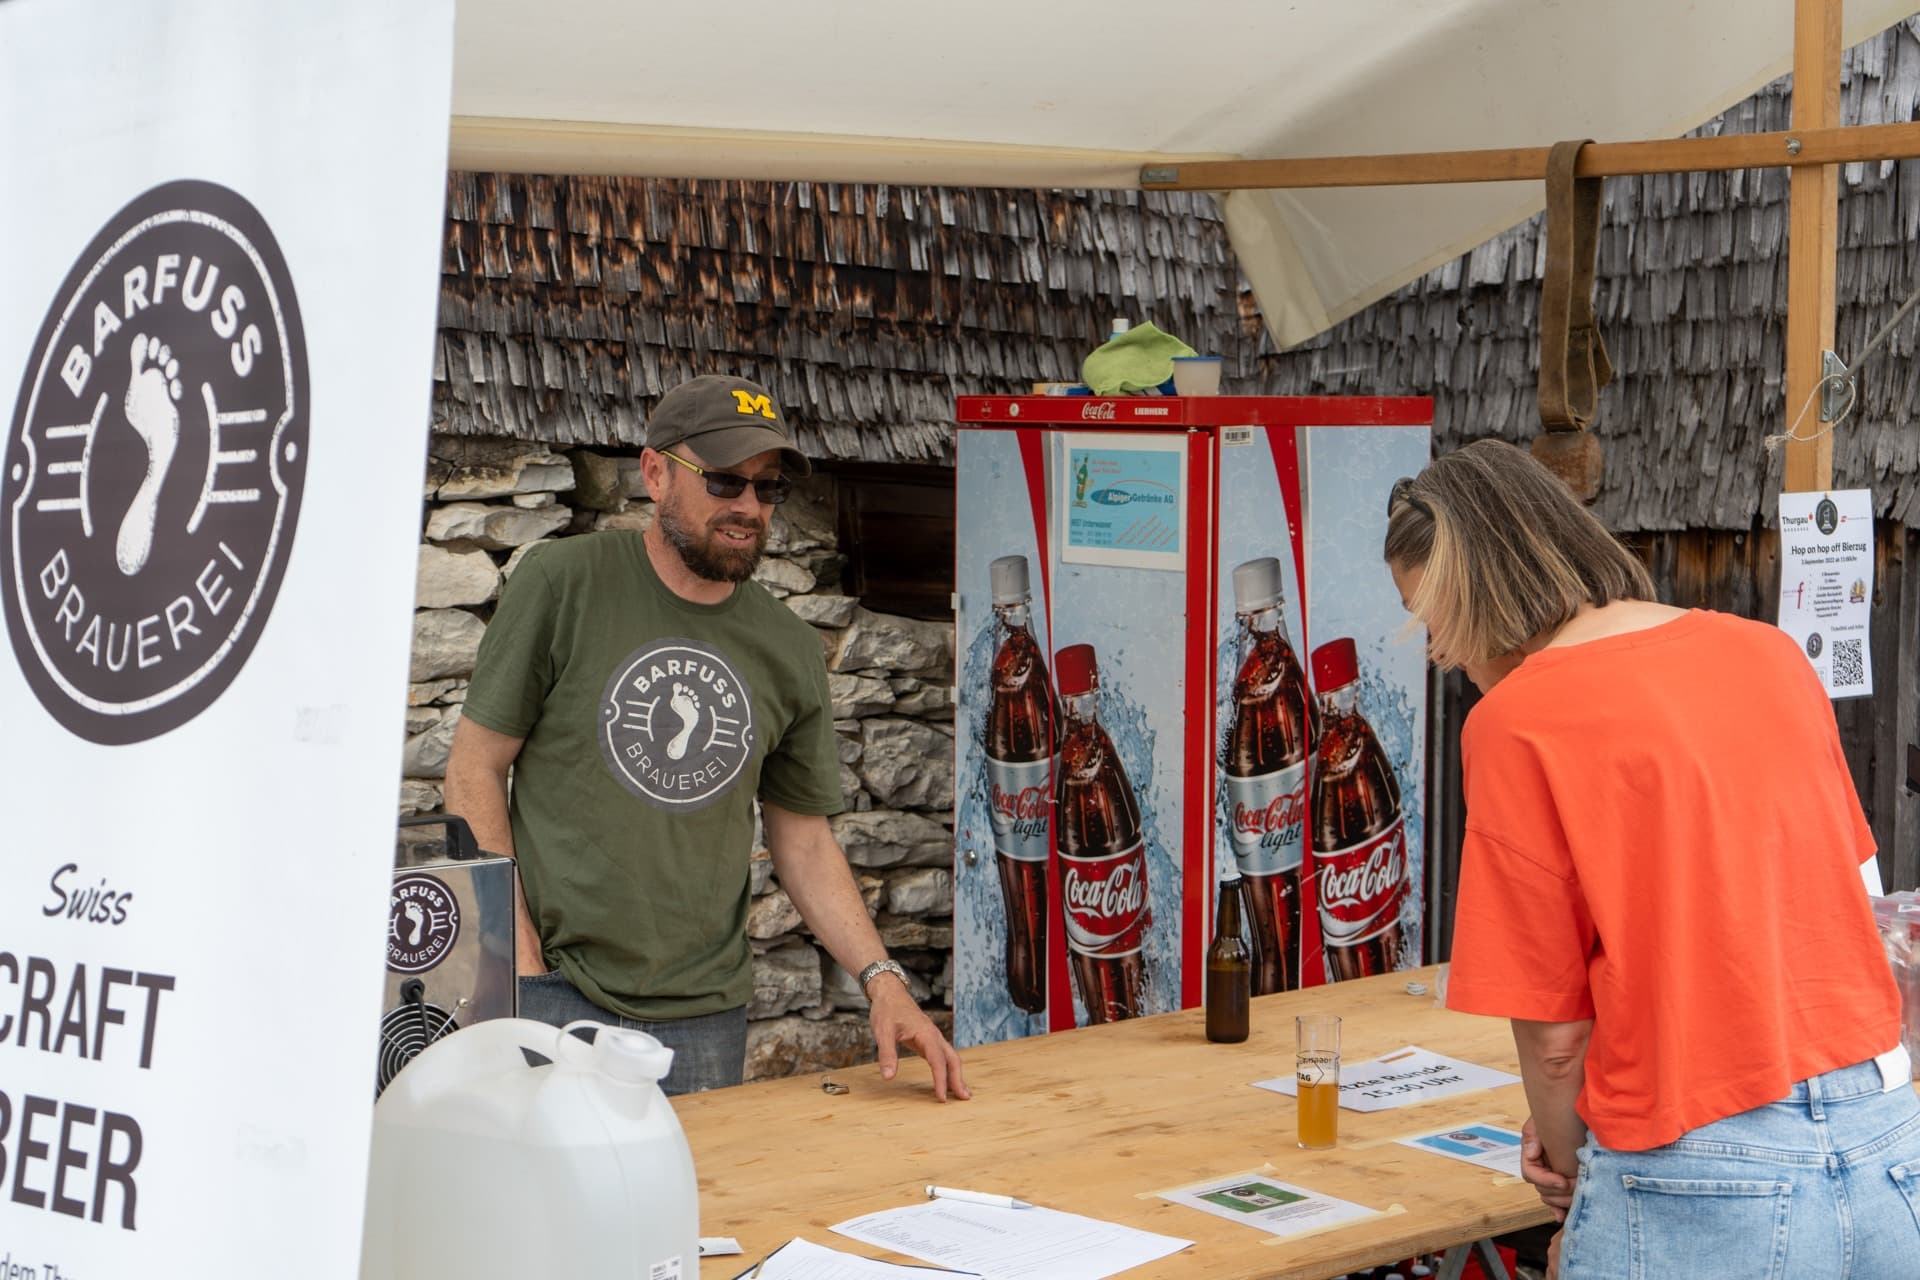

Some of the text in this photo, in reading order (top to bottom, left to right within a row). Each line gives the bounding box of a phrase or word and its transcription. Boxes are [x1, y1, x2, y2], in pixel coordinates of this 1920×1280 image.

[60, 253, 263, 378] BARFUSS
[731, 389, 777, 420] M
[1782, 516, 1808, 526] Thurgau
[1791, 545, 1806, 556] Hop
[1817, 543, 1830, 554] hop
[1842, 541, 1867, 552] Bierzug
[39, 541, 244, 672] BRAUEREI
[633, 659, 737, 709] BARFUSS
[626, 742, 728, 790] BRAUEREI
[1013, 818, 1048, 841] light
[1260, 828, 1301, 854] light
[1065, 857, 1143, 919] Coca-Cola
[1320, 834, 1401, 910] Coca-Cola
[42, 863, 132, 925] Swiss
[391, 885, 443, 908] ARFUSS
[0, 952, 176, 1070] CRAFT
[1338, 1064, 1453, 1092] etzte Runde
[1420, 1075, 1465, 1088] Uhr
